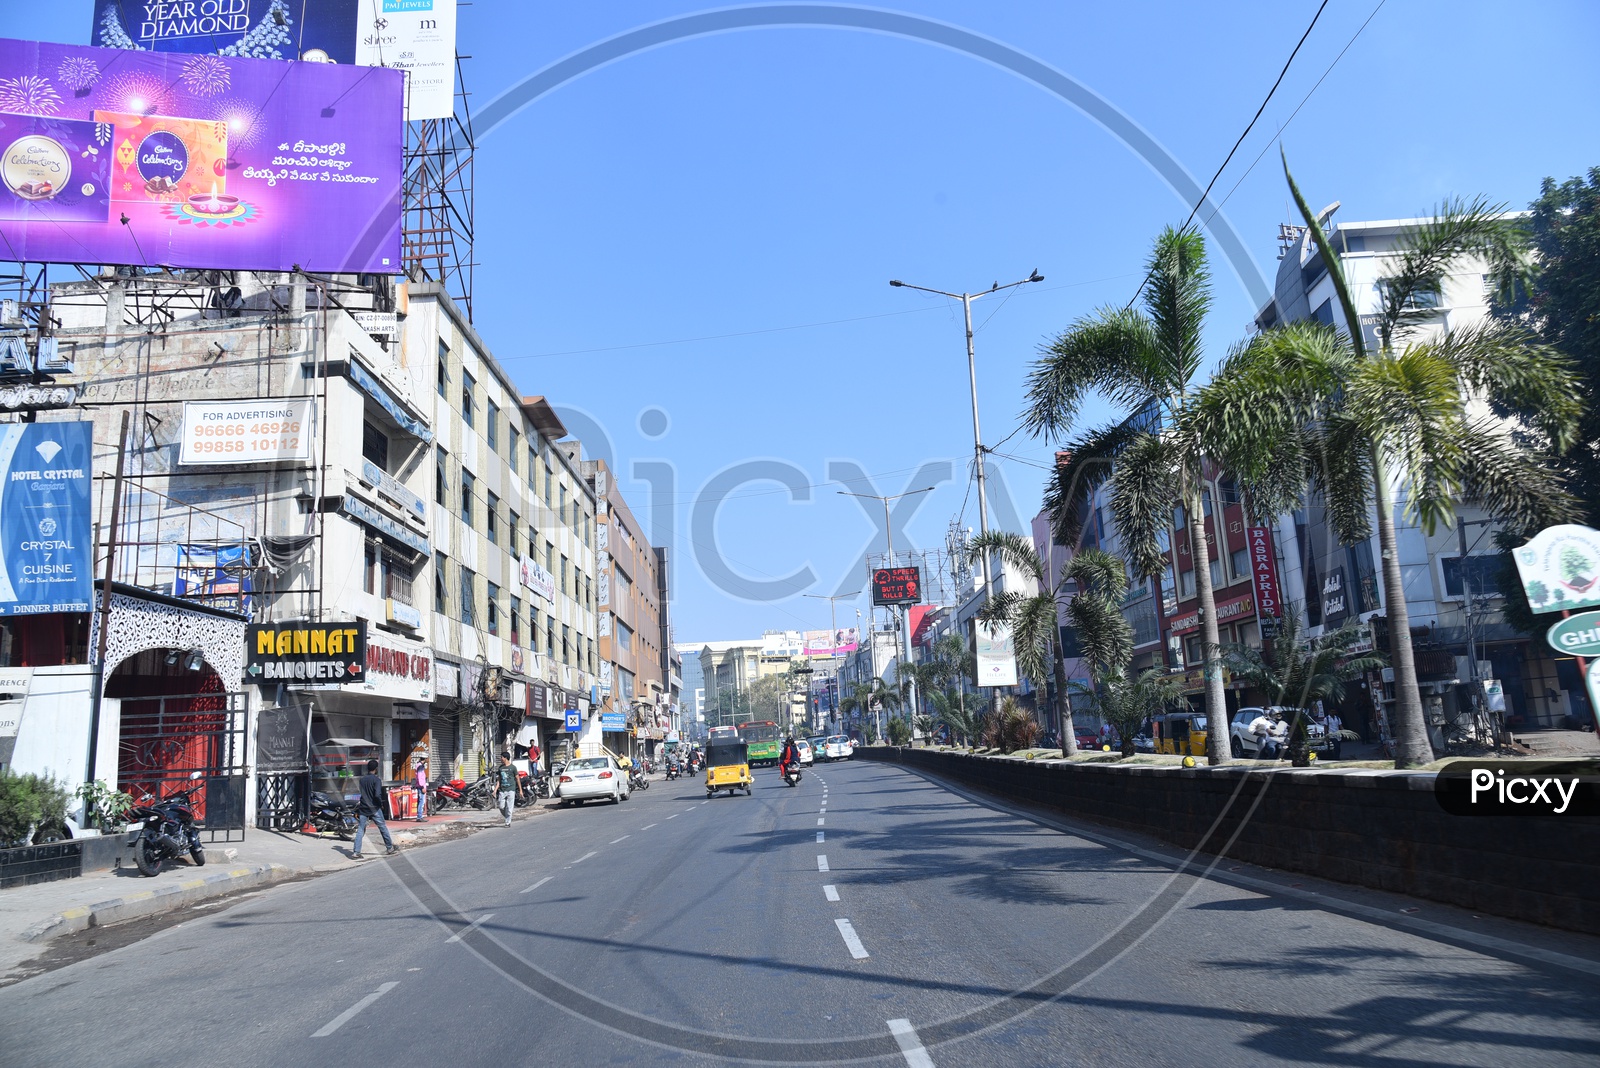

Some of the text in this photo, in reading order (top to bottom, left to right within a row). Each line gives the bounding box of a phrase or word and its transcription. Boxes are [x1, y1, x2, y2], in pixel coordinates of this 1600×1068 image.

[143, 0, 246, 21] YEAR OLD
[402, 1, 431, 9] JEWELS
[140, 15, 250, 38] DIAMOND
[364, 34, 397, 46] shree
[203, 410, 293, 420] FOR ADVERTISING
[194, 422, 300, 436] 96666 46926
[193, 438, 299, 453] 99858 10112
[12, 469, 84, 482] HOTEL CRYSTAL
[20, 540, 75, 550] CRYSTAL
[1252, 530, 1270, 570] BASRA
[44, 553, 52, 562] 7
[23, 564, 73, 574] CUISINE
[892, 574, 918, 582] THRILLS
[1259, 574, 1276, 616] PRIDE
[13, 603, 88, 614] DINNER BUFFET
[257, 628, 358, 657] MANNAT
[264, 660, 345, 680] BANQUETS
